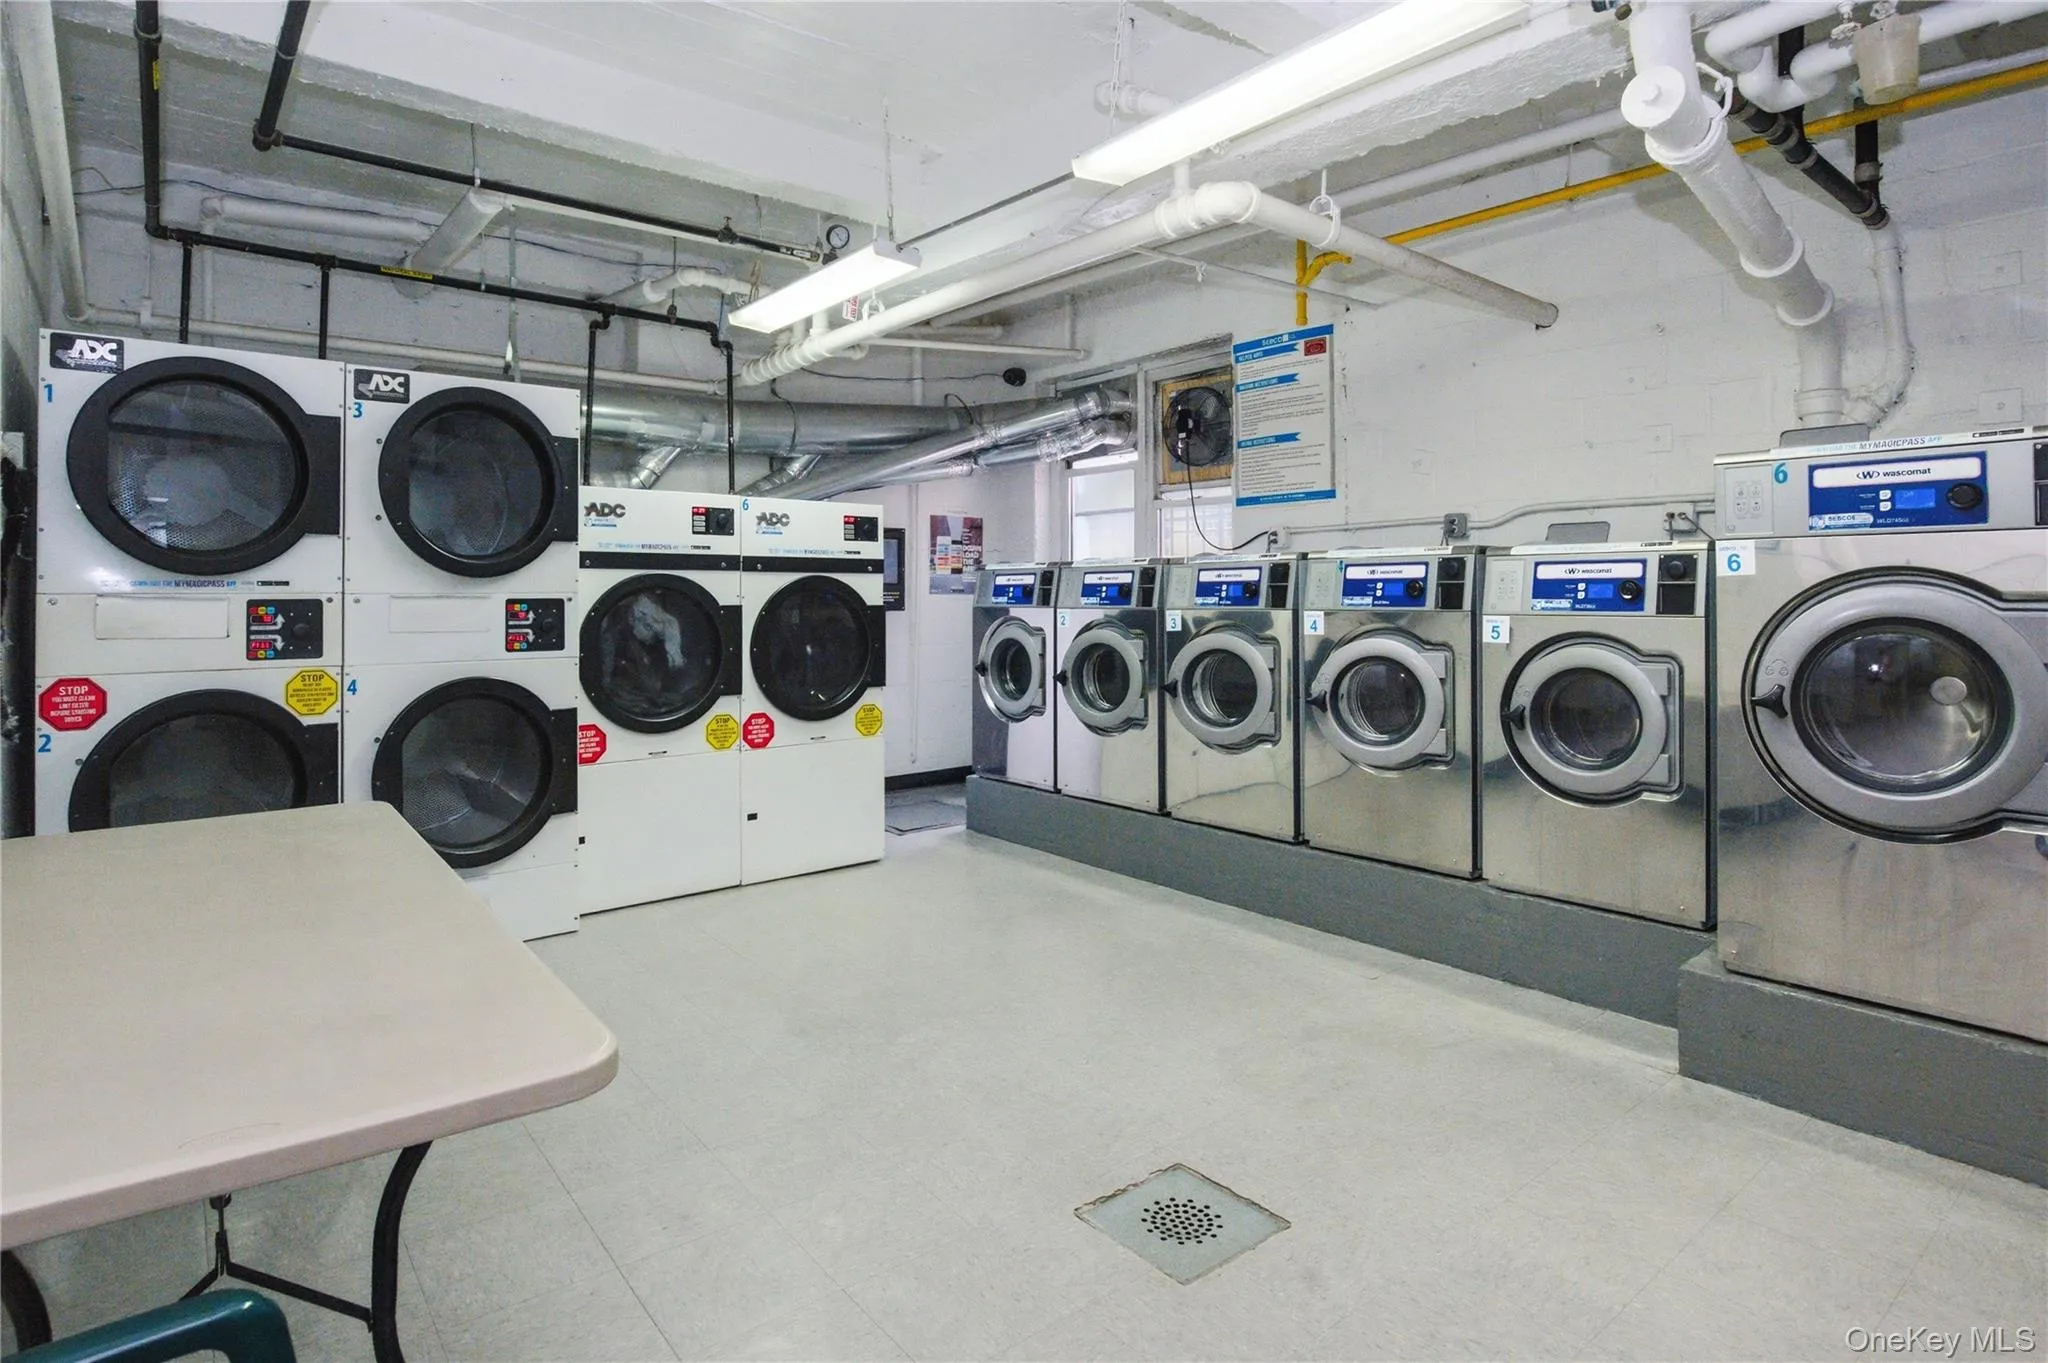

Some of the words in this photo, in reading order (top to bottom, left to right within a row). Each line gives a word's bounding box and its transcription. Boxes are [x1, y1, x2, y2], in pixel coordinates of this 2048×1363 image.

[68, 339, 118, 362] ADC
[368, 373, 405, 393] ADC
[44, 384, 52, 402] 1
[352, 402, 363, 418] 3
[1859, 437, 1926, 450] MYMAGICPASS
[1774, 462, 1788, 484] 6
[1882, 467, 1932, 477] wascomat
[584, 502, 626, 518] ADC
[743, 498, 749, 510] 6
[756, 512, 790, 527] ADC
[1727, 554, 1741, 572] 6
[174, 579, 225, 588] MYMAGICPASS
[1060, 615, 1067, 626] 2
[1170, 618, 1177, 629] 3
[1310, 619, 1319, 632] 4
[1490, 625, 1501, 640] 5
[300, 674, 325, 683] STOP
[59, 686, 89, 696] STOP
[346, 679, 358, 696] 4
[38, 734, 52, 753] 2
